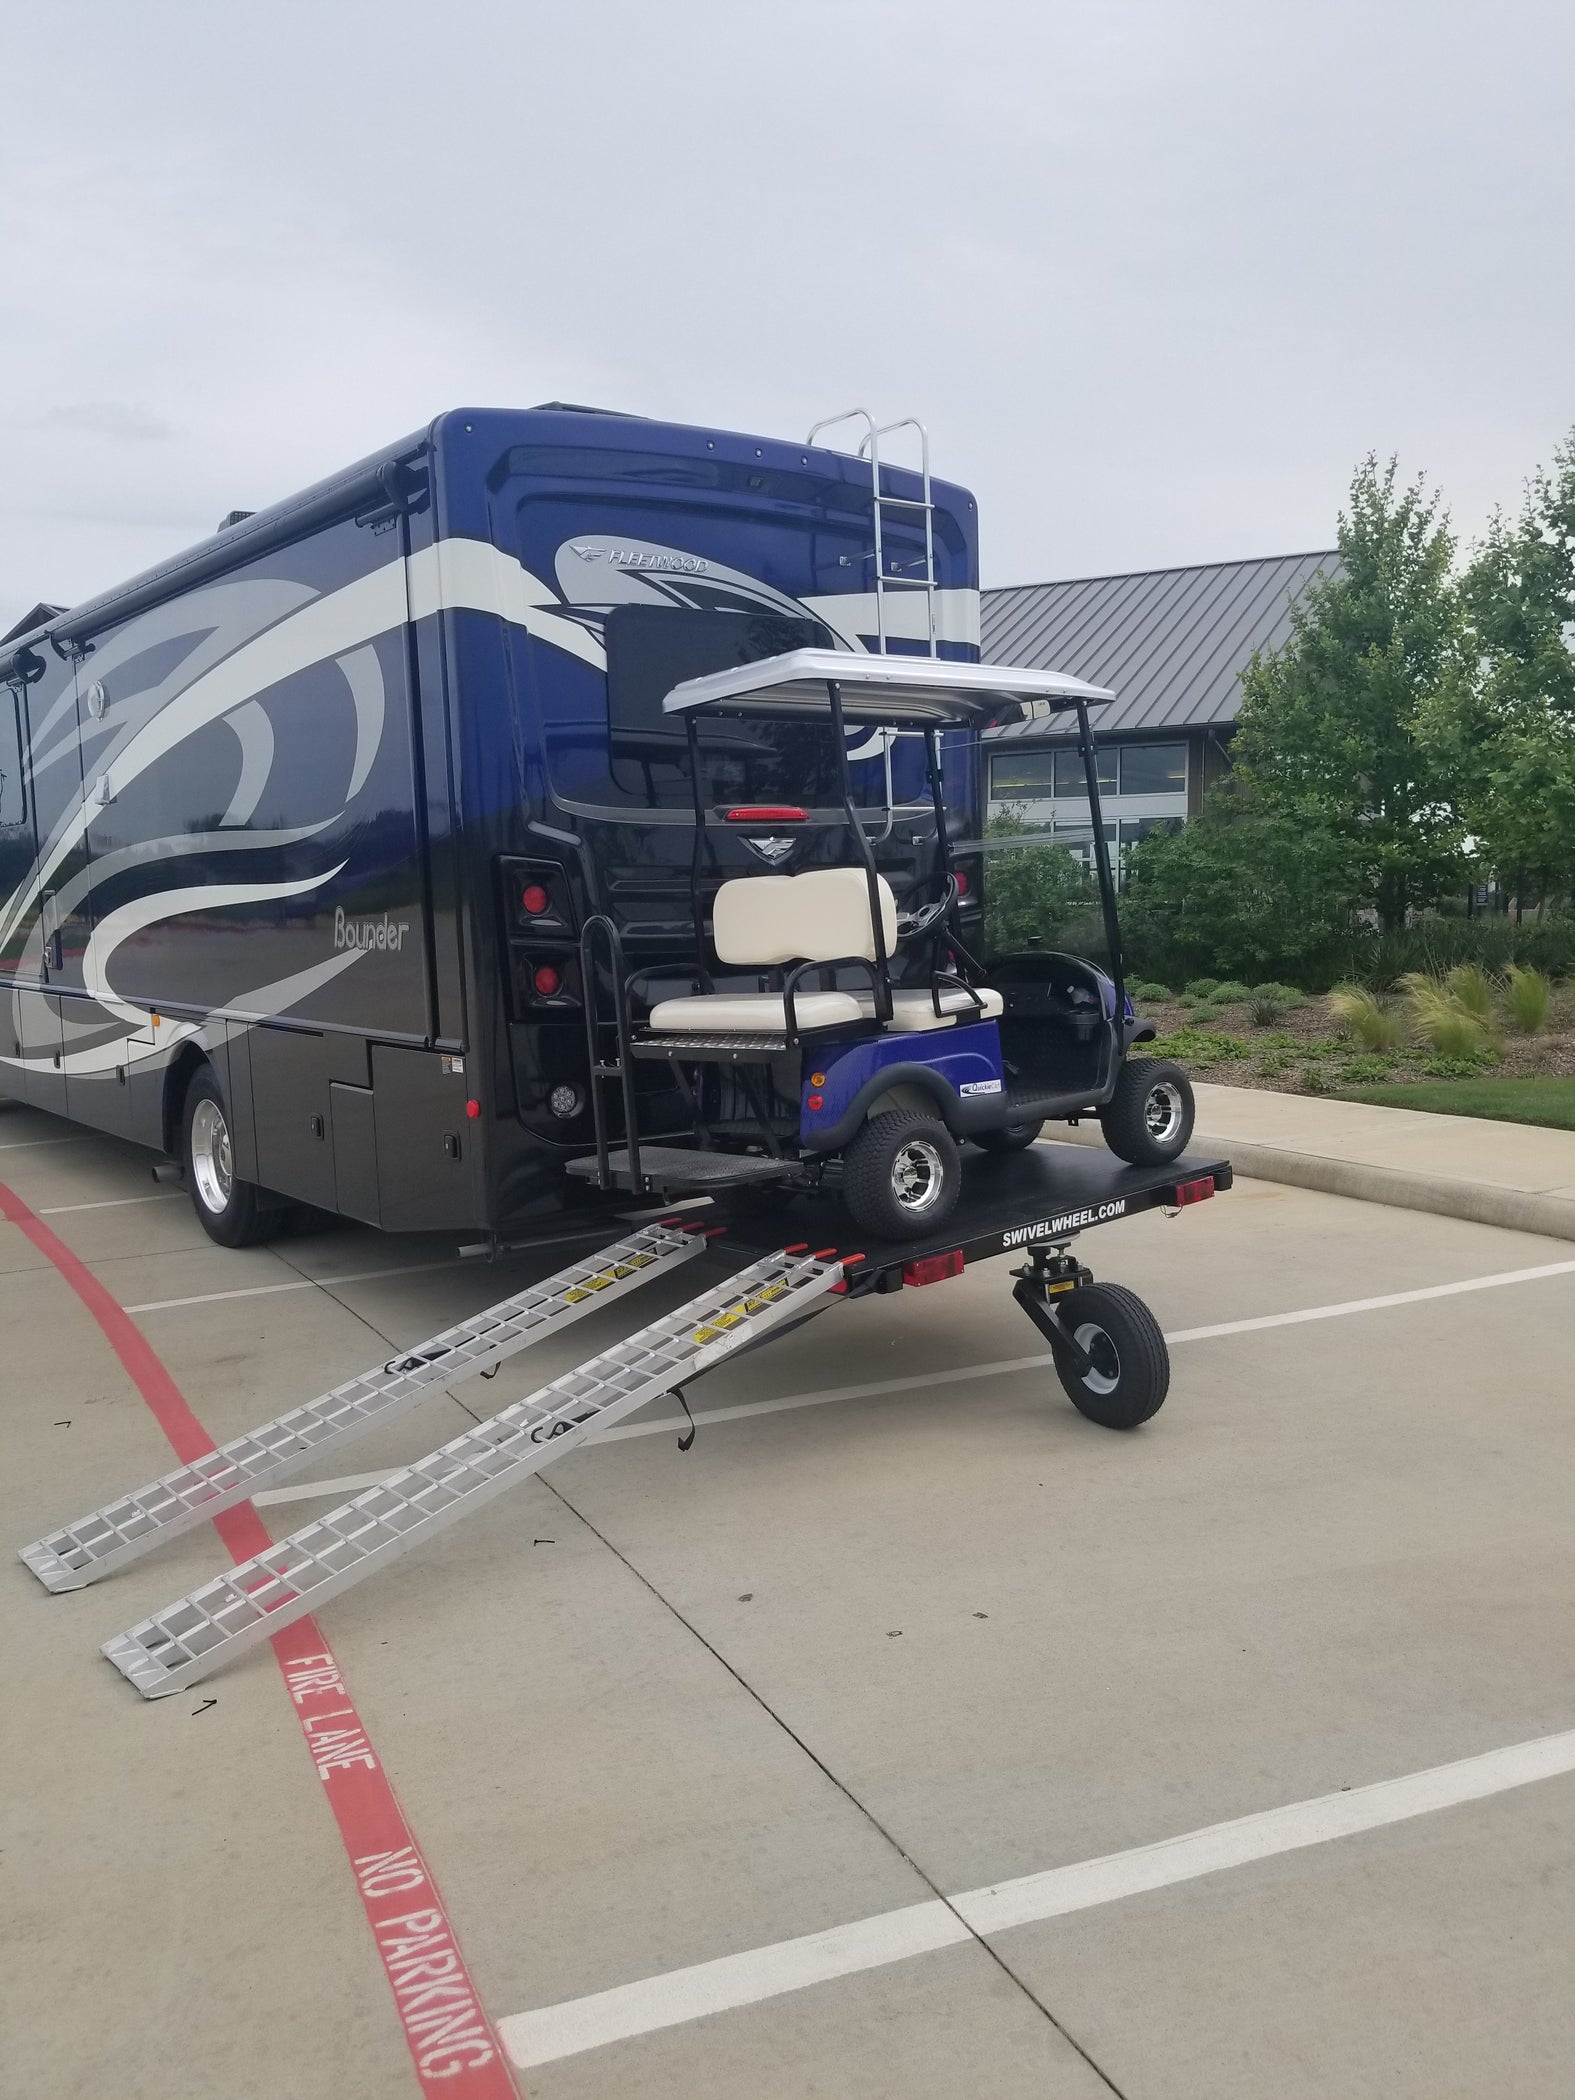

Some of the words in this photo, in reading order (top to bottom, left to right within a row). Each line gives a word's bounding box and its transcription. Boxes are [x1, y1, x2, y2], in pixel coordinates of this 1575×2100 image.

[608, 549, 709, 574] FLEETWOOD
[334, 905, 410, 951] Bounder
[1002, 1199, 1126, 1247] SWIVELWHEEL.COM
[285, 1653, 346, 1704] FIRE
[303, 1709, 376, 1781] LANE
[354, 1846, 424, 1898] NO
[375, 1908, 493, 2078] PARKING
